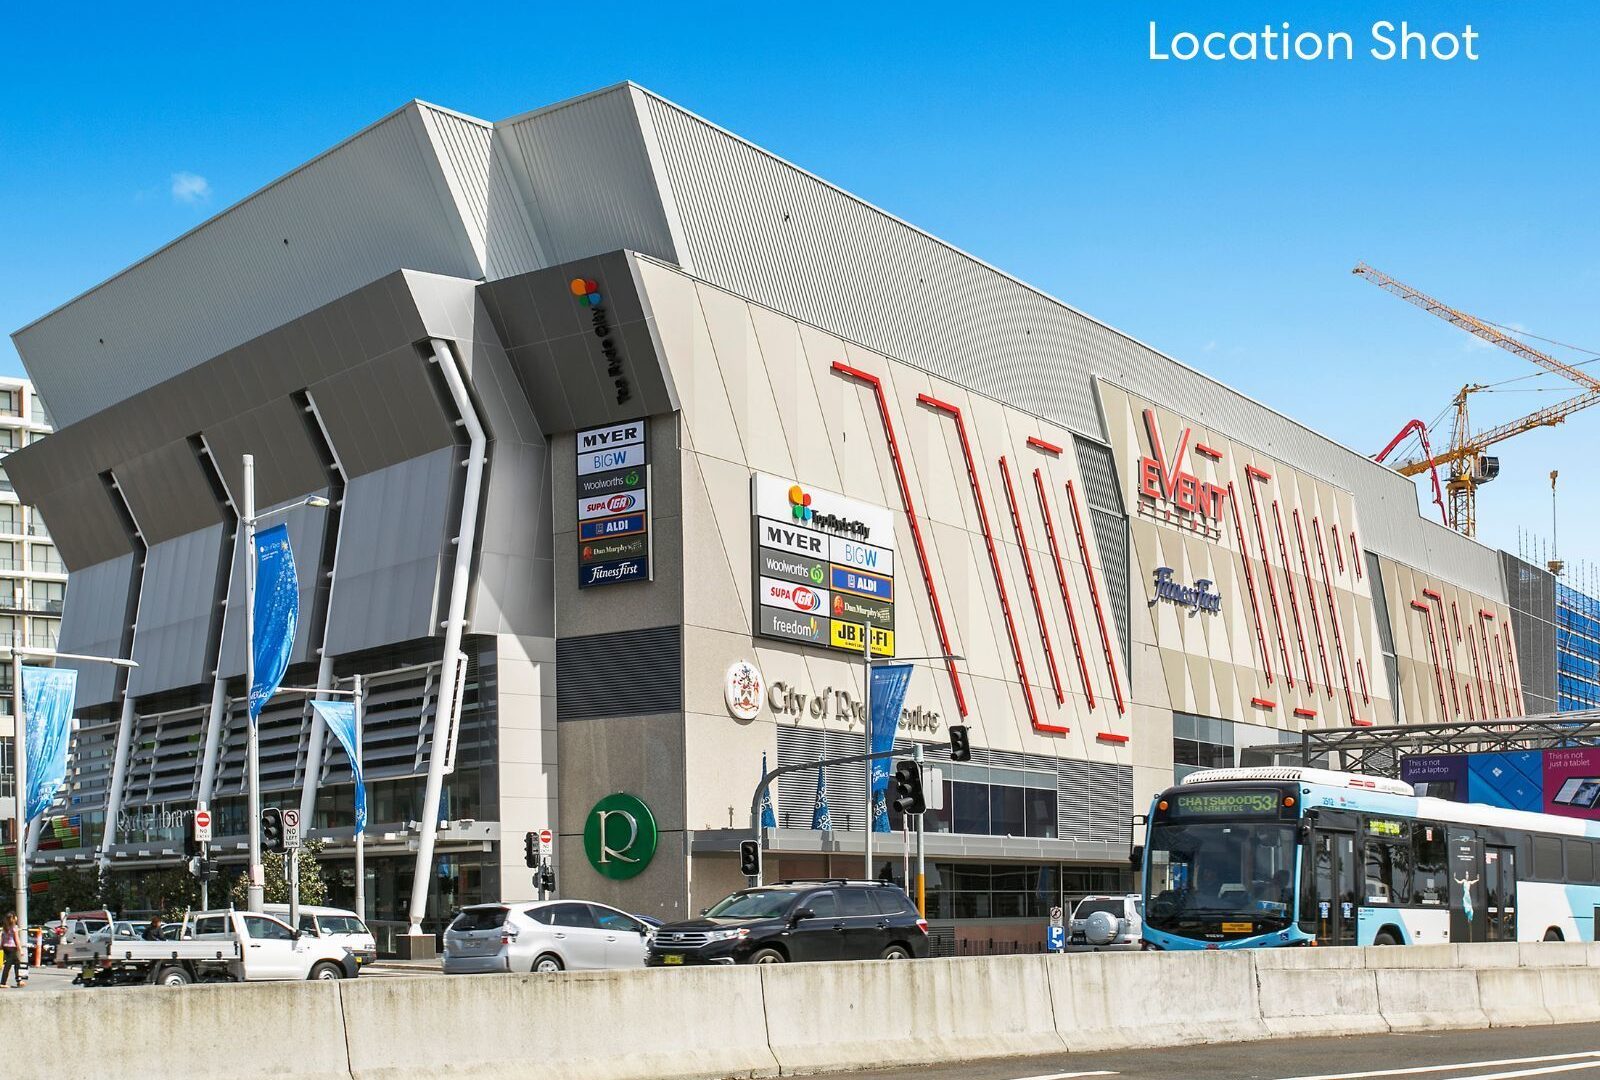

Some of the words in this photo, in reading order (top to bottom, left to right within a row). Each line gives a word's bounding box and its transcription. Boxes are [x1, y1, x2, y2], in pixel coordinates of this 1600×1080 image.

[583, 427, 638, 448] MYER
[1139, 408, 1229, 523] EVENT
[586, 501, 606, 513] SUPA
[609, 497, 627, 510] IGA
[606, 519, 629, 533] ALDI
[767, 525, 822, 554] MYER
[593, 547, 606, 556] Dan
[856, 577, 877, 593] ALDI
[770, 586, 791, 600] SUPA
[794, 589, 813, 606] IGA
[844, 602, 857, 613] Dan
[773, 616, 812, 637] freedom
[837, 624, 856, 641] JB
[767, 681, 806, 729] City
[809, 686, 832, 720] of
[1408, 759, 1421, 767] This
[1422, 759, 1428, 767] is
[1428, 759, 1440, 767] not
[1548, 760, 1562, 769] just
[1569, 758, 1591, 768] tablet
[1549, 752, 1562, 760] This
[1563, 752, 1569, 760] is
[1569, 752, 1584, 760] not
[1407, 767, 1421, 776] just
[1427, 765, 1449, 775] laptop
[1177, 796, 1253, 807] CHATSWOOD
[1222, 804, 1244, 812] RYDE
[596, 809, 641, 864] R
[1052, 927, 1063, 939] P
